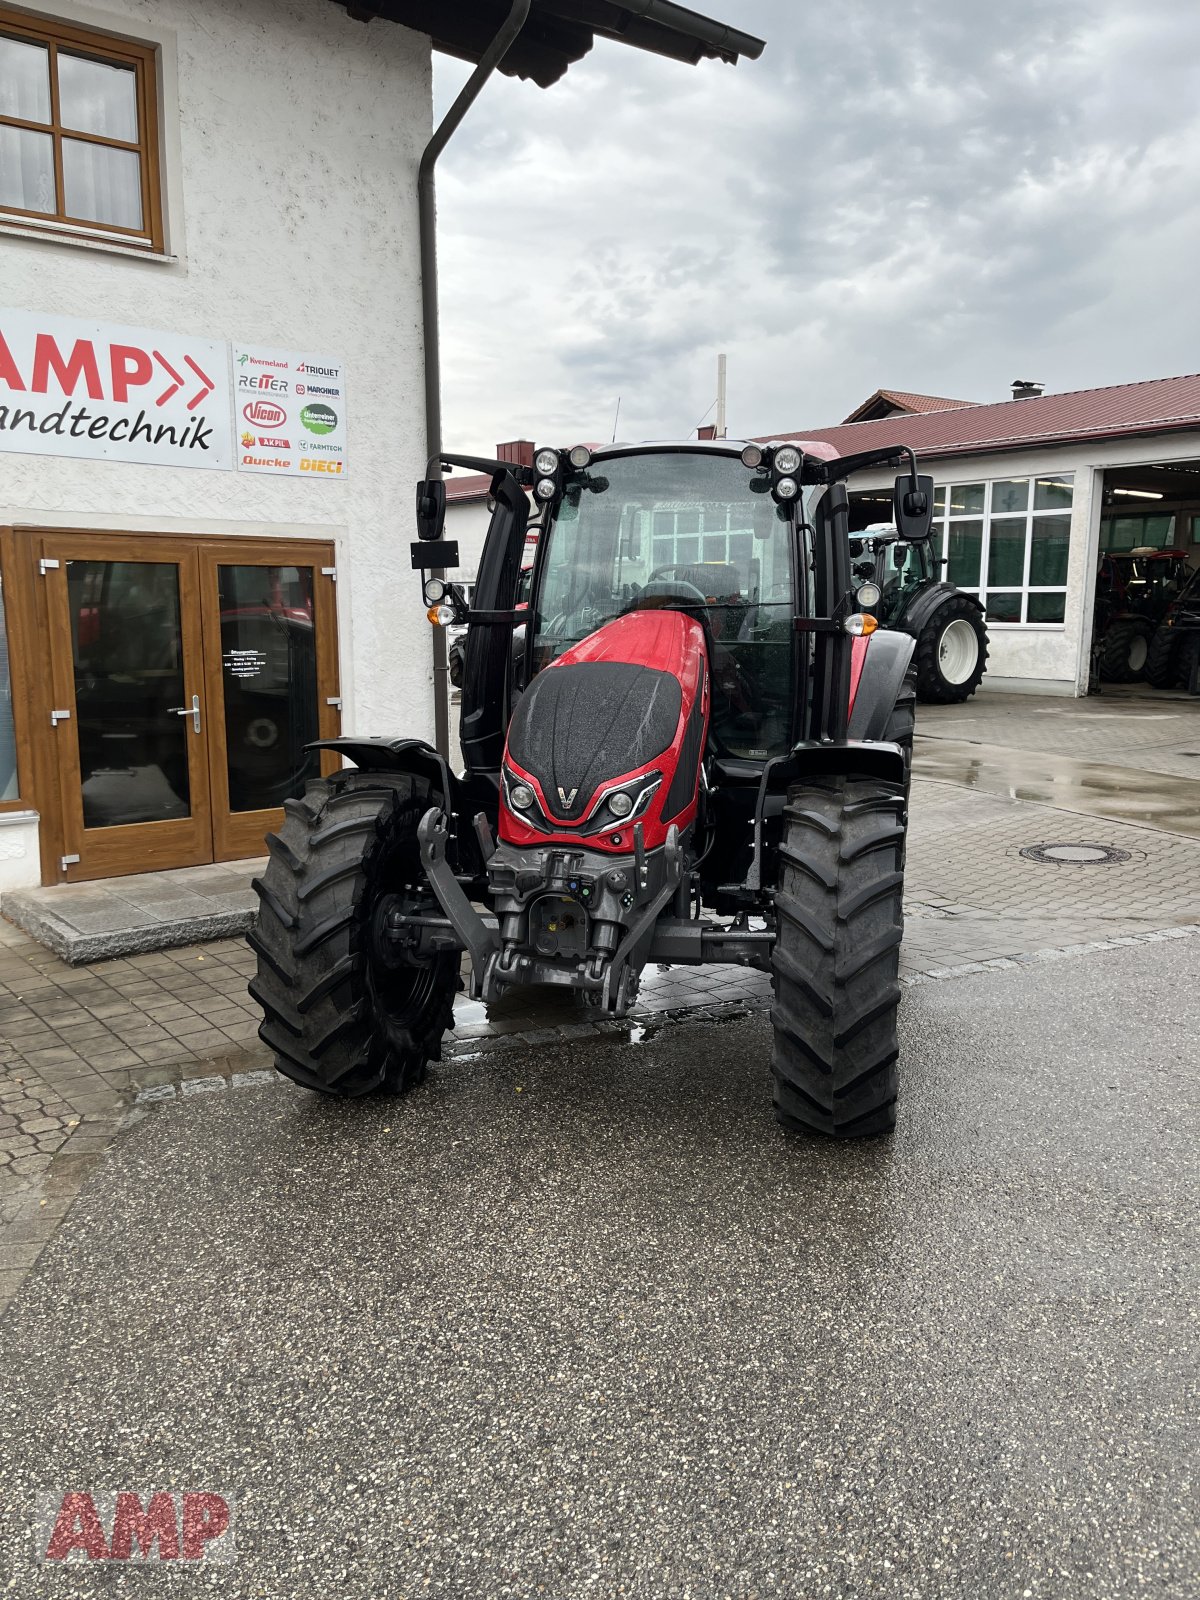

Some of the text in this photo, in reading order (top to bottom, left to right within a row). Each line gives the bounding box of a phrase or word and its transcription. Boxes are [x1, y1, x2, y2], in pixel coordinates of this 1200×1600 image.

[249, 356, 288, 369] Kverneland
[305, 365, 339, 377] TRIOLIET
[239, 374, 288, 392] REITER
[249, 402, 281, 422] Vicon
[263, 438, 285, 448] AKPIL
[309, 443, 342, 452] FARMTECH
[243, 456, 290, 468] Quicke
